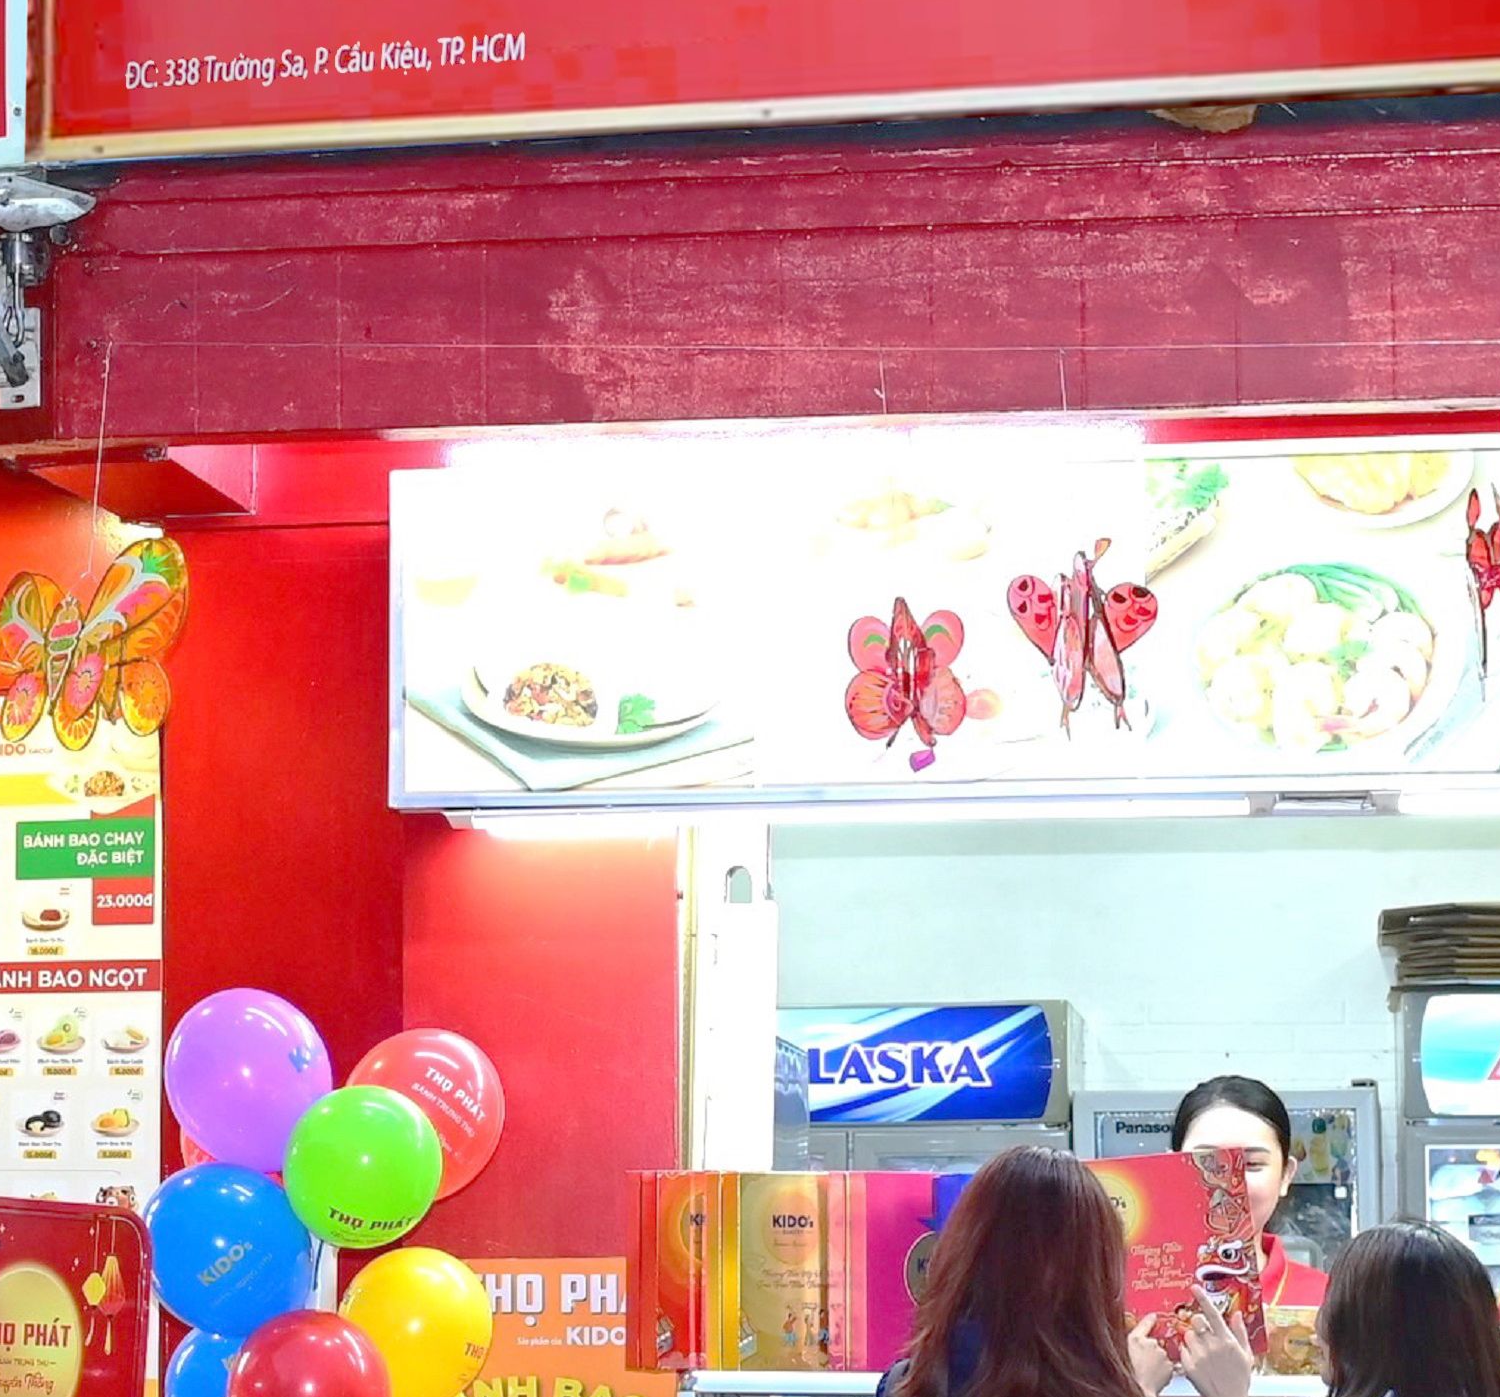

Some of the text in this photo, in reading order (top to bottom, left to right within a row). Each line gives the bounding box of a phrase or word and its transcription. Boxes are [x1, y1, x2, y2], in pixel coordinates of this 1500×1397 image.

[23, 832, 144, 849] BÁNH BAO CHAY
[76, 848, 144, 867] ĐẶC BIỆT
[96, 893, 153, 908] 23.000đ
[37, 972, 83, 988] BAO
[87, 969, 147, 991] NGỌT
[425, 1066, 486, 1122] THỌ PHÁT
[328, 1207, 364, 1231] THỌ
[772, 1213, 814, 1230] KIDO's
[23, 1318, 72, 1344] PHÁT
